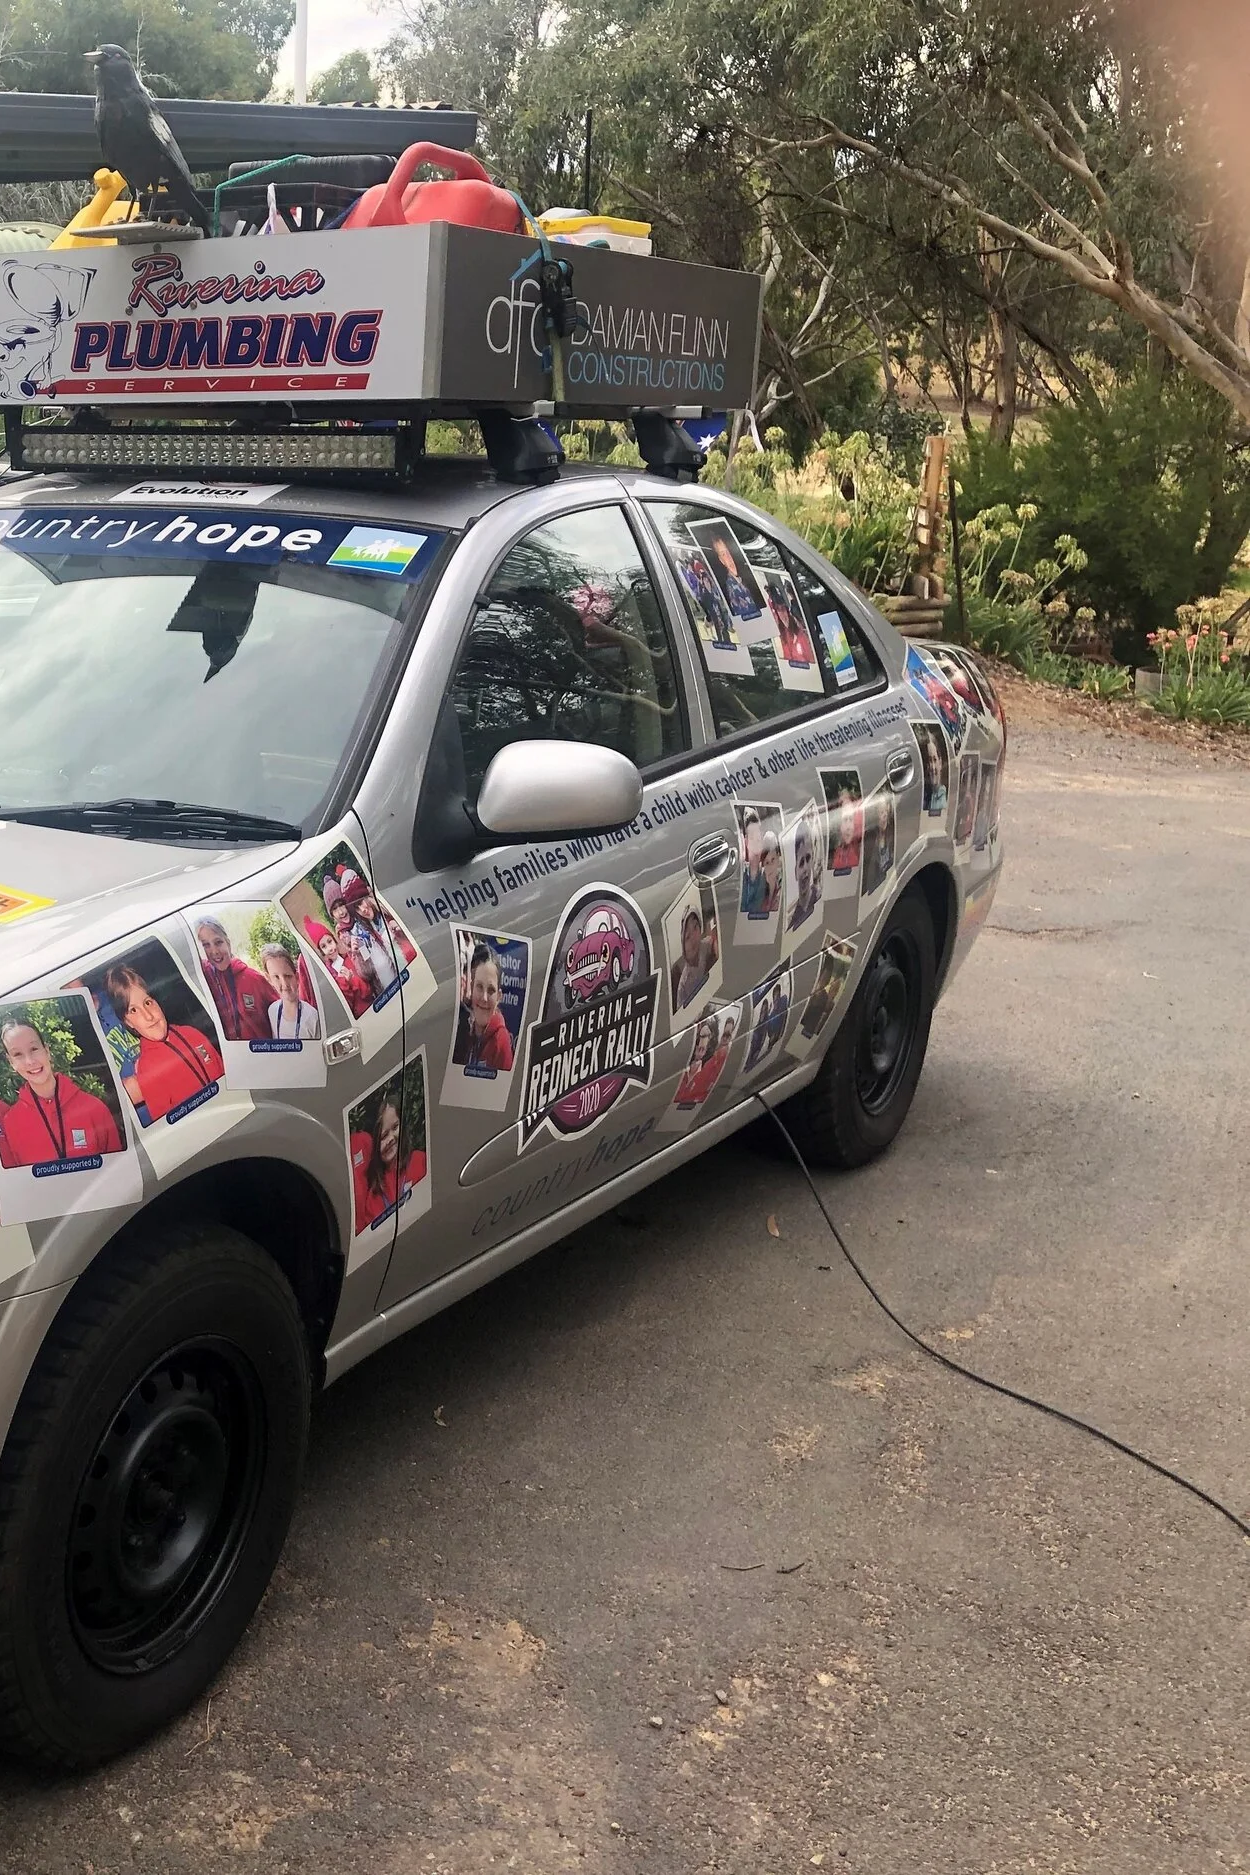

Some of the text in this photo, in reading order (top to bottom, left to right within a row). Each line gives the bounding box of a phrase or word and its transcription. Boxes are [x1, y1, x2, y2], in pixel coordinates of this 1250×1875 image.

[129, 252, 326, 317] Riverina
[71, 309, 384, 372] PLUMBING
[571, 300, 730, 359] DAMIAN FLINN
[85, 376, 348, 392] SERVICE
[567, 351, 725, 393] CONSTRUCTIONS
[130, 486, 249, 496] Evolution
[494, 846, 568, 894] families
[566, 836, 603, 862] who
[639, 811, 653, 831] a
[651, 793, 688, 826] child
[684, 779, 714, 812] with
[715, 766, 754, 800] cancer
[754, 757, 769, 779] &
[768, 746, 798, 776] other
[796, 738, 817, 762] life
[815, 716, 873, 754] threatening
[500, 992, 519, 1006] ntre
[558, 993, 632, 1048] RIVERINA
[527, 1012, 651, 1127] REDNECK RALLY
[578, 1082, 601, 1119] 2020
[36, 1158, 101, 1176] proudly supported by
